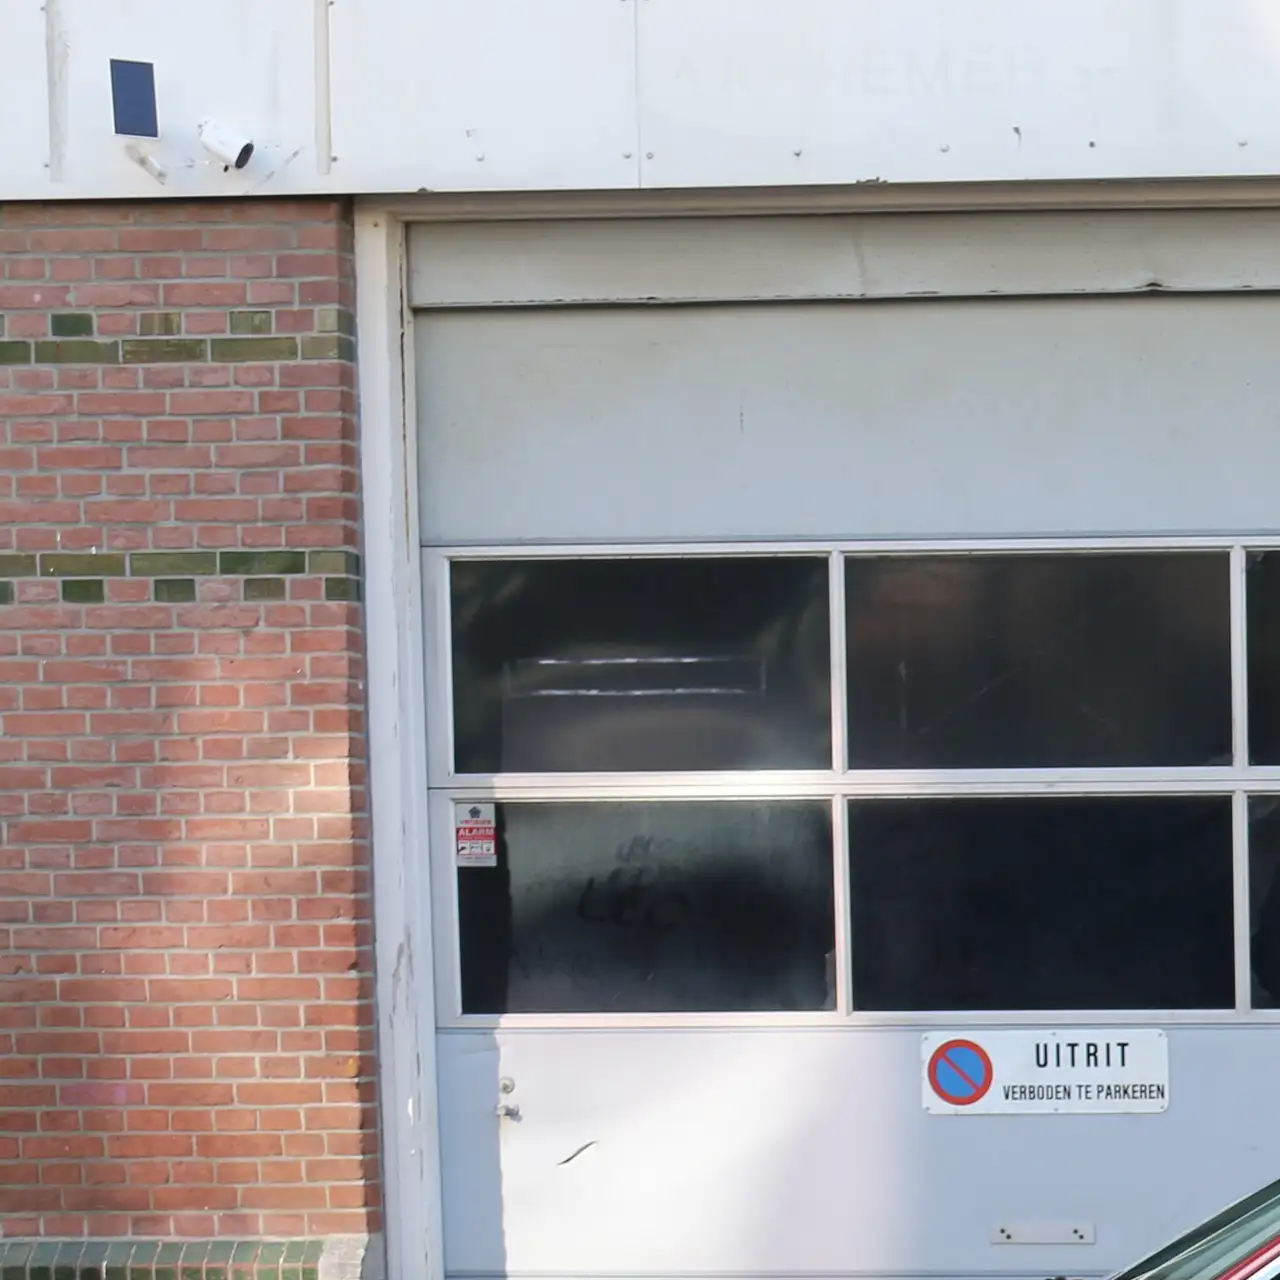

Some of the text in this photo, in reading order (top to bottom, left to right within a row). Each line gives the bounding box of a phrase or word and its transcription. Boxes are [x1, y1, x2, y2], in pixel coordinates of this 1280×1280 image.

[458, 827, 495, 837] ALARM
[1035, 1042, 1129, 1068] UITRIT
[1003, 1083, 1165, 1100] VERBODEN TE PARKEREN
